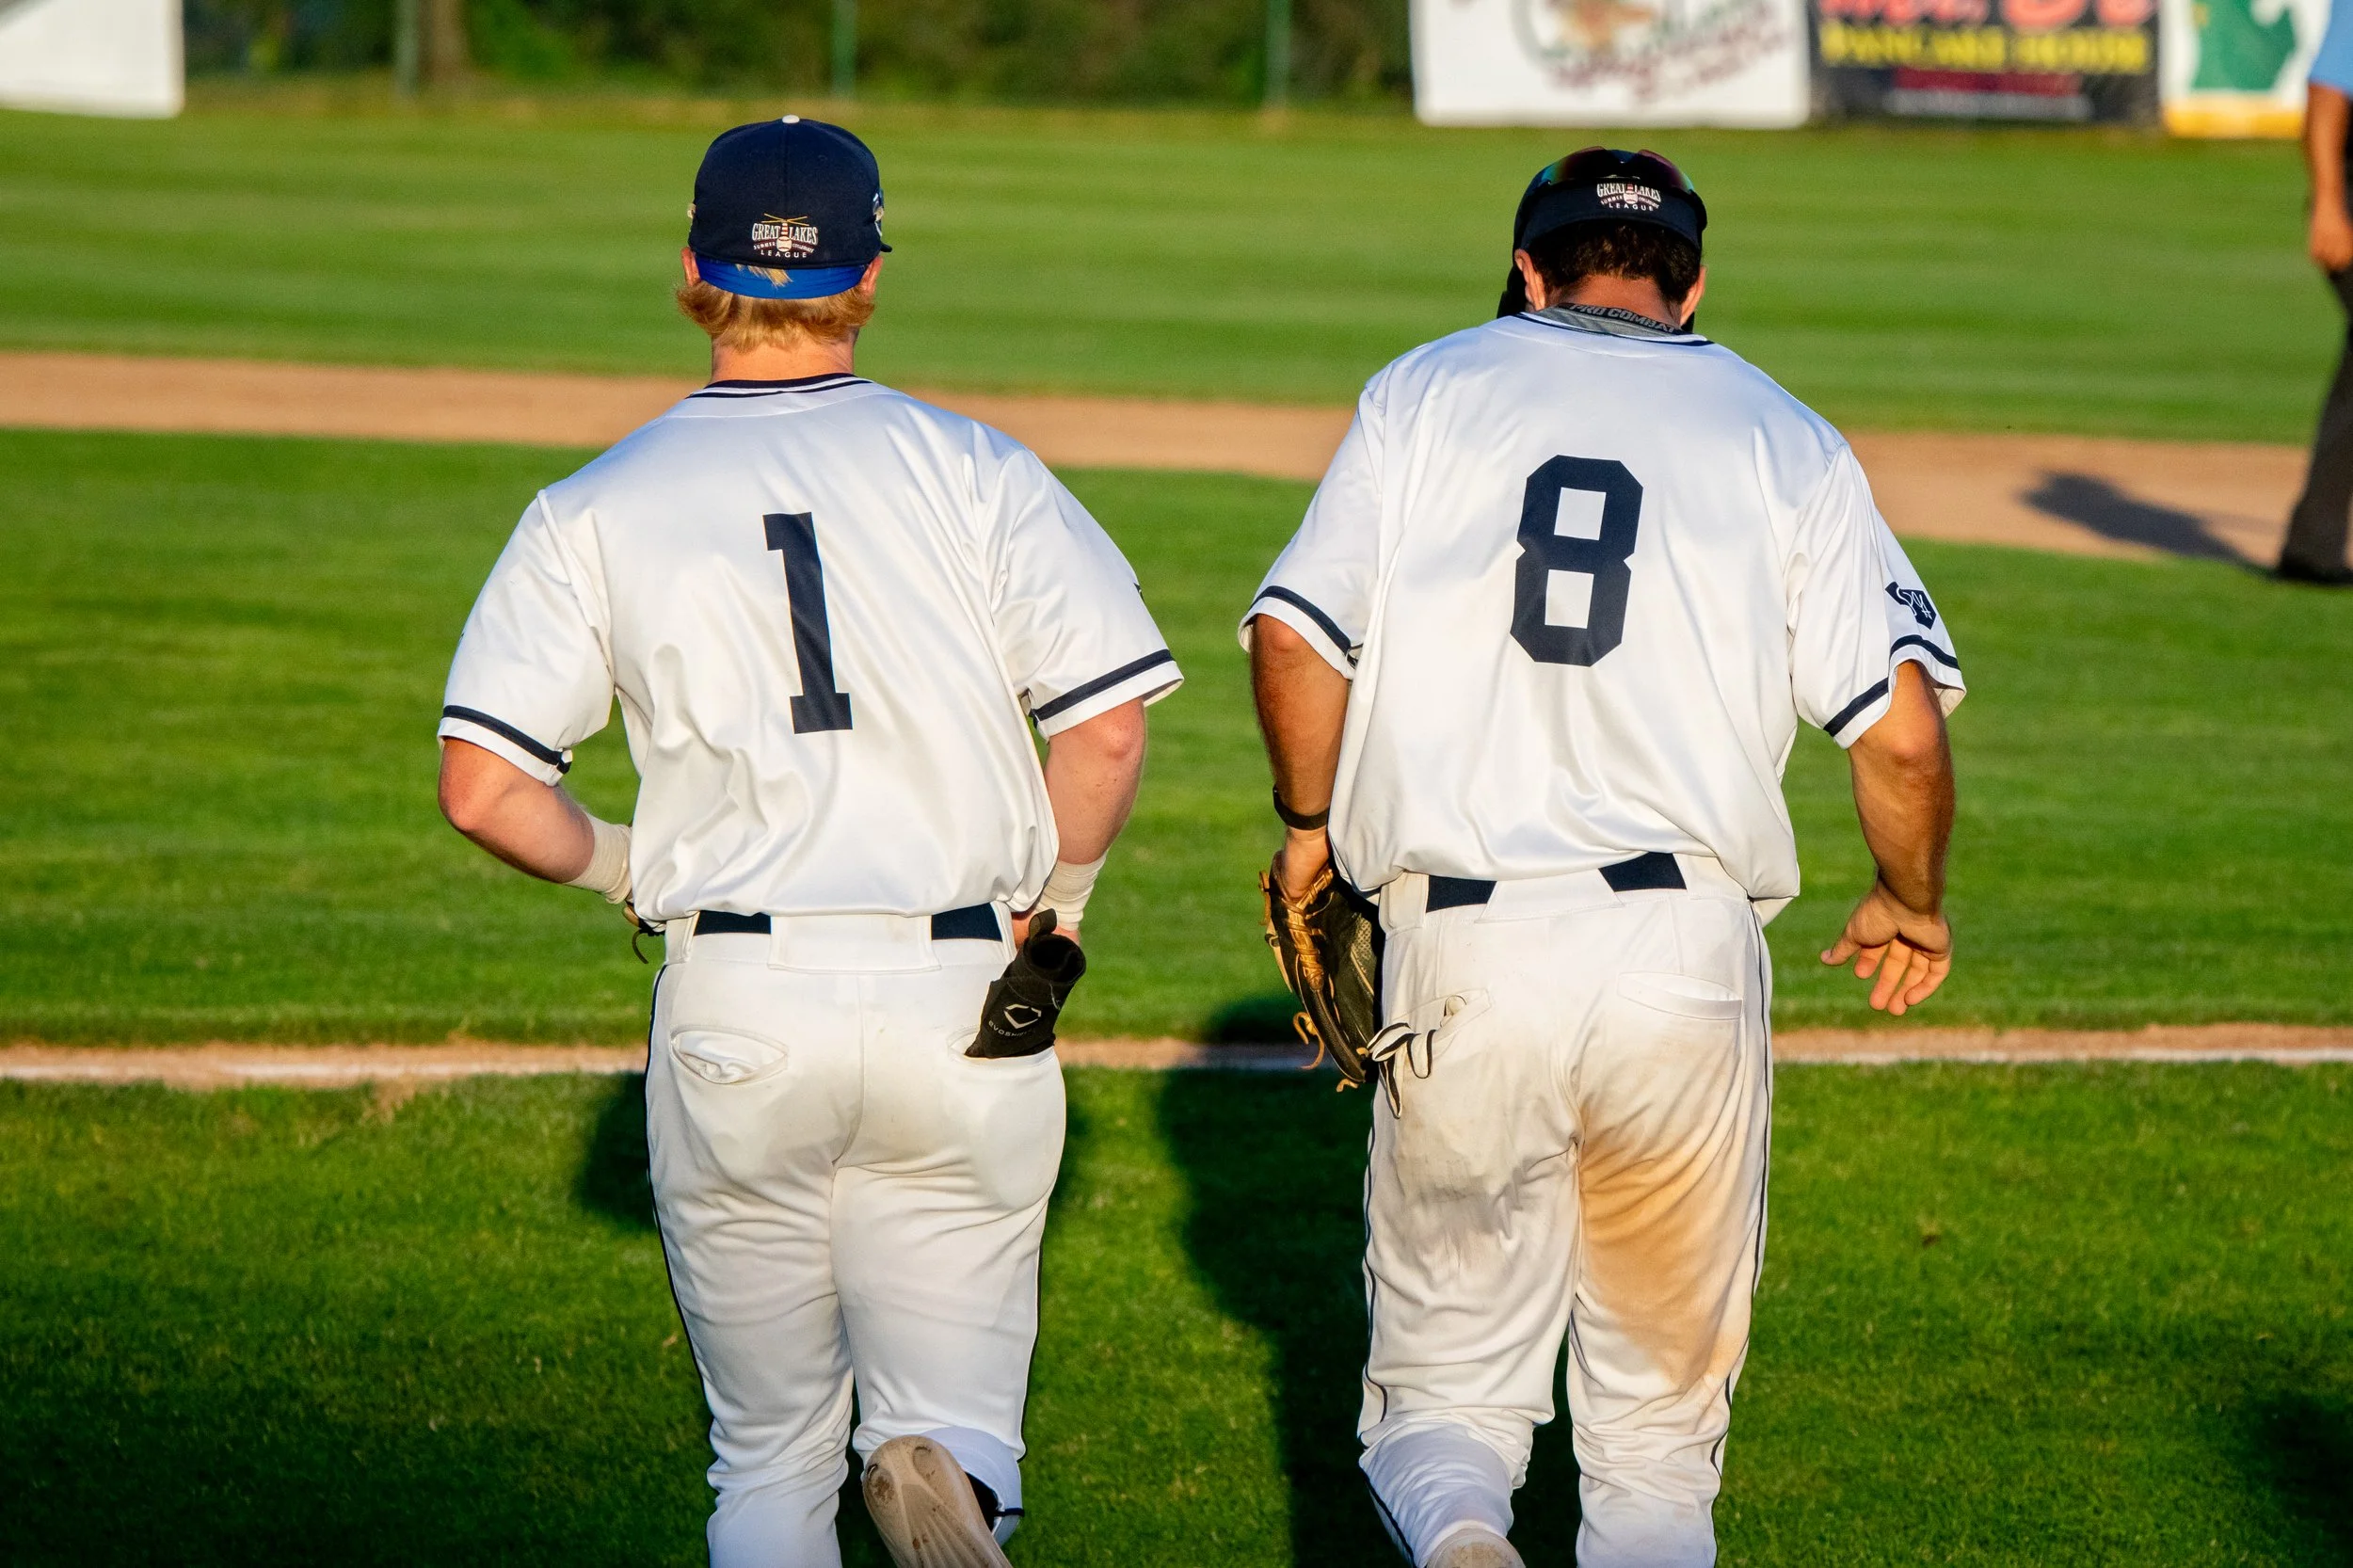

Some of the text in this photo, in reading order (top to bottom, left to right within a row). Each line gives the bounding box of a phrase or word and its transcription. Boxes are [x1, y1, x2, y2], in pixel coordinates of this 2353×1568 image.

[1596, 183, 1626, 198] GREAT
[1634, 184, 1661, 202] LAKES
[1609, 202, 1654, 212] LEAGUE
[752, 223, 818, 246] GREAT LAKES
[1570, 304, 1676, 333] PRO COMBAT
[1510, 455, 1643, 667] 8
[762, 511, 853, 734] 1
